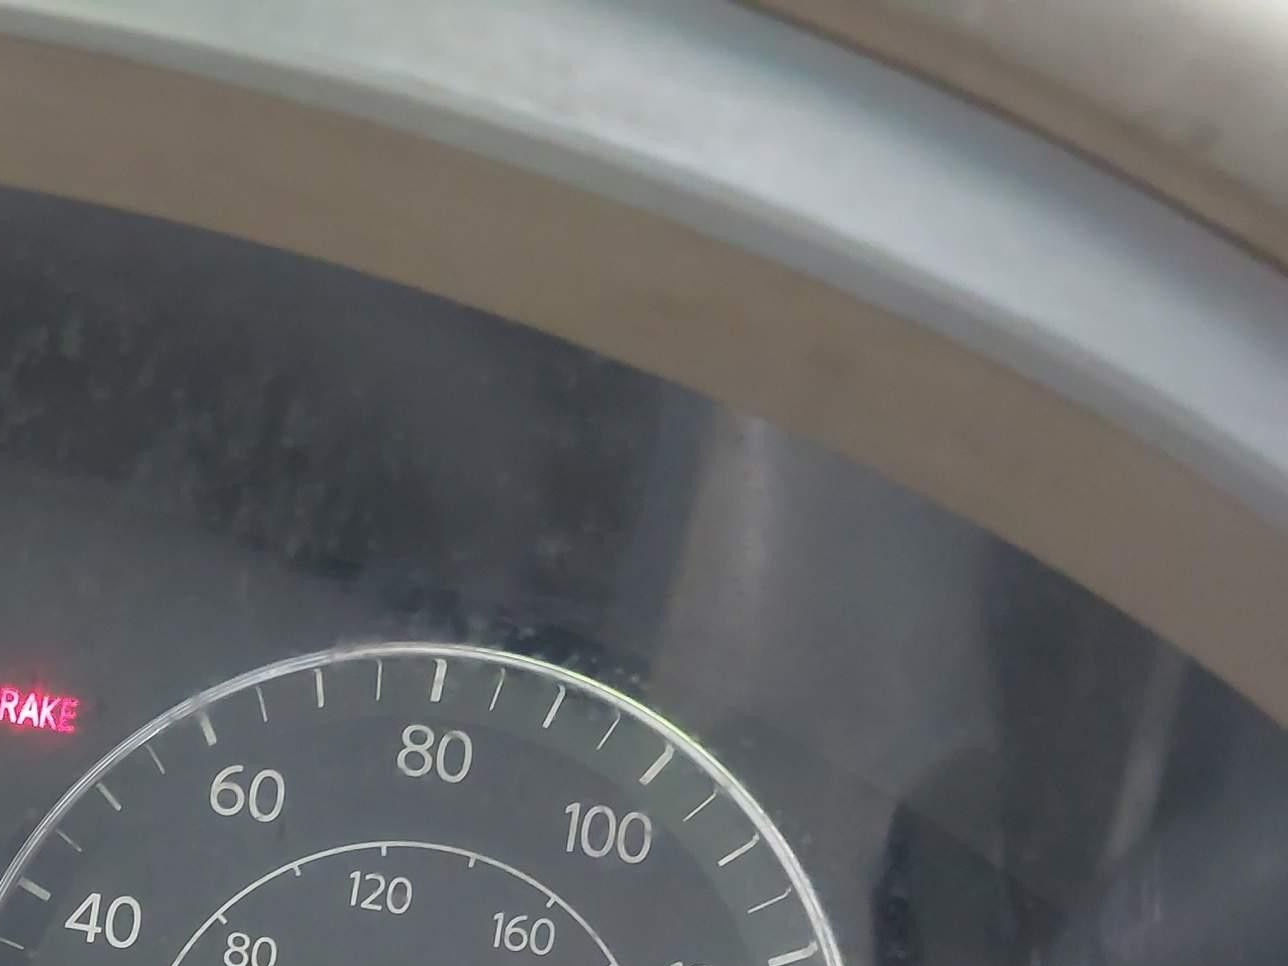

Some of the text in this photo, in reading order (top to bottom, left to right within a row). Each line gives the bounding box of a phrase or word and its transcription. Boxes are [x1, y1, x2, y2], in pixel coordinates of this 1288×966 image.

[396, 724, 473, 783] 80
[210, 764, 286, 823] 60
[563, 802, 653, 864] 100
[64, 892, 142, 949] 40
[347, 870, 413, 915] 120
[492, 912, 556, 956] 160
